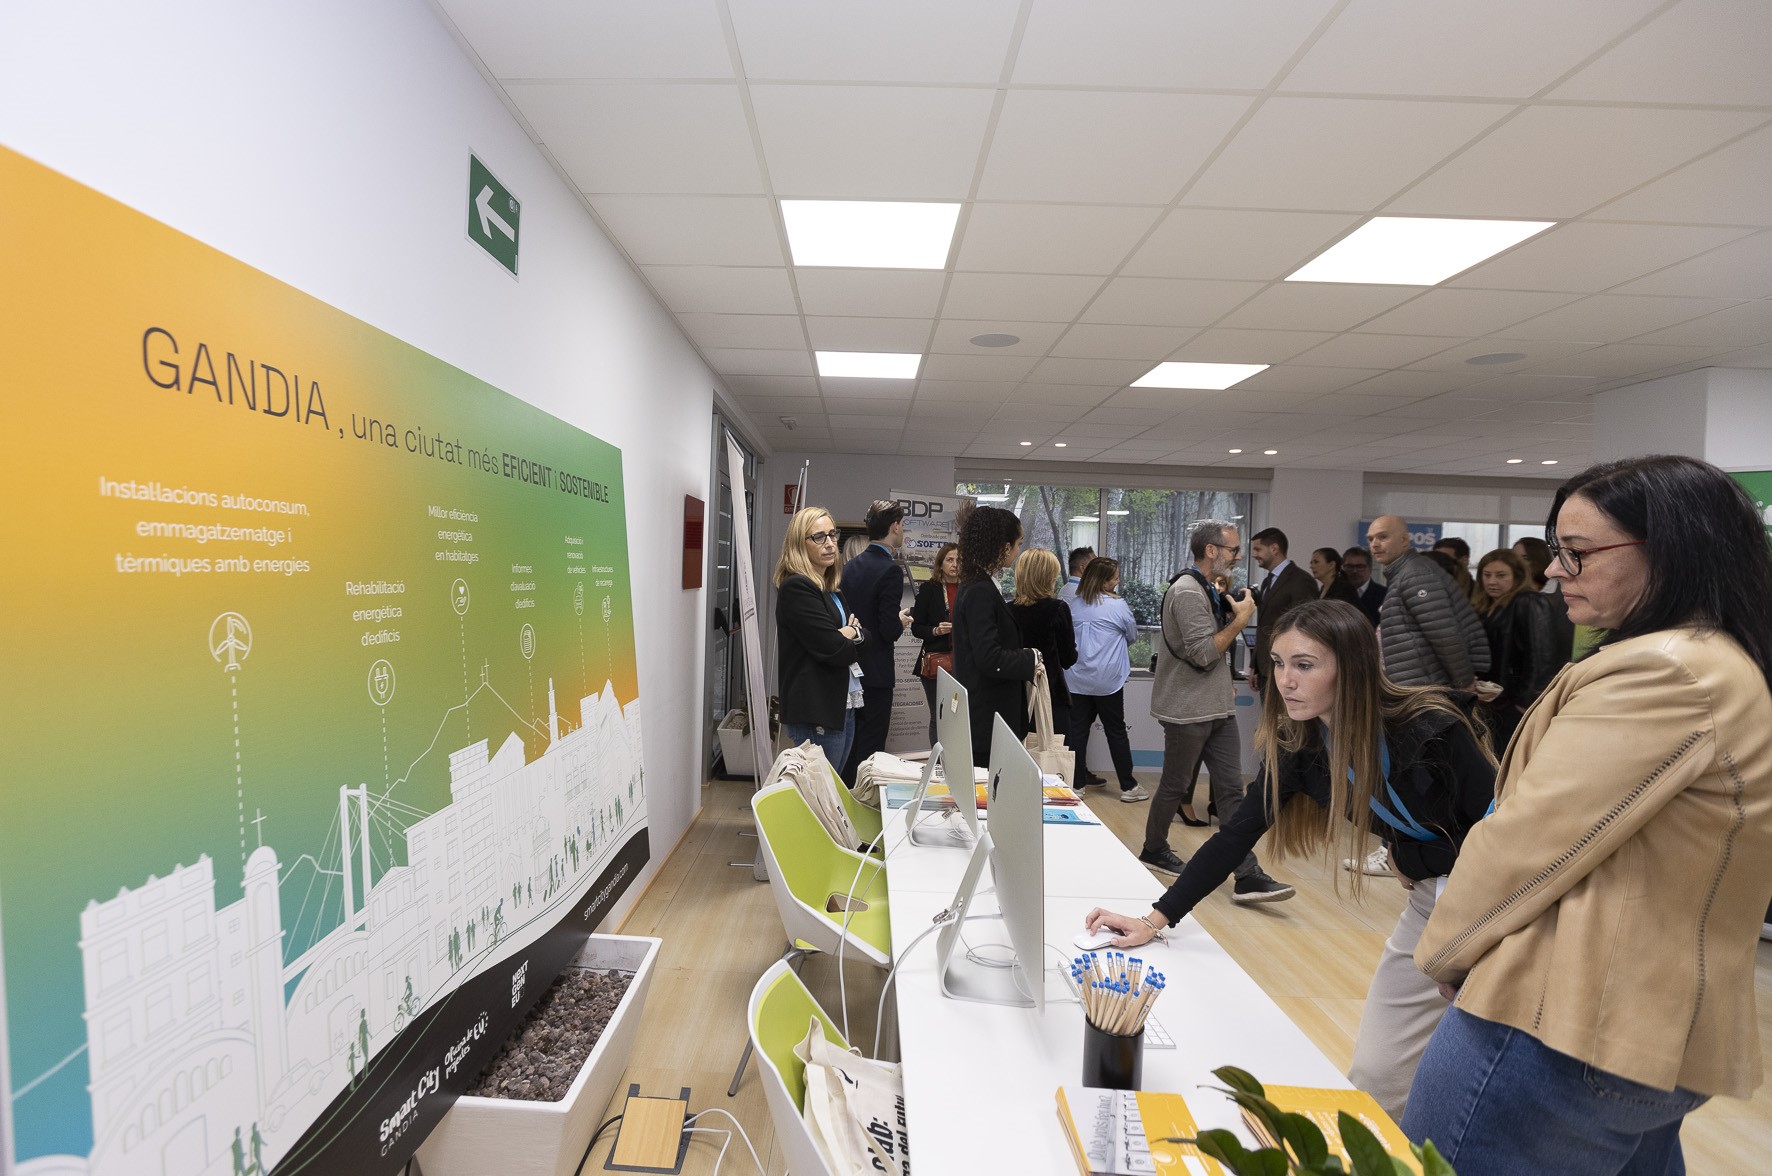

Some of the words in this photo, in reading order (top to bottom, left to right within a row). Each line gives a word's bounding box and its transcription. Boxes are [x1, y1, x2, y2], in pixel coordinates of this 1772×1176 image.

[352, 413, 398, 448] una
[405, 426, 463, 464] ciutat
[468, 447, 499, 475] més
[502, 452, 552, 488] EFICIENT
[554, 470, 558, 490] i
[559, 471, 609, 503] SOSTENIBLE
[221, 493, 310, 516] autoconsum,
[428, 505, 448, 519] Millor
[136, 520, 285, 546] emmagatzematge
[288, 527, 292, 543] i
[903, 518, 949, 528] OFTWARE
[214, 555, 250, 573] amb
[253, 556, 310, 576] energies
[435, 551, 445, 561] en
[446, 550, 479, 564] habitatges
[511, 563, 532, 574] Informes
[346, 580, 405, 595] Rehabilitació
[361, 628, 401, 646] d'edificis
[583, 863, 629, 921] smartcitygandia.com
[473, 1018, 485, 1041] EU
[379, 1089, 418, 1142] Smart
[417, 1065, 440, 1100] City
[381, 1109, 419, 1157] GANDIA
